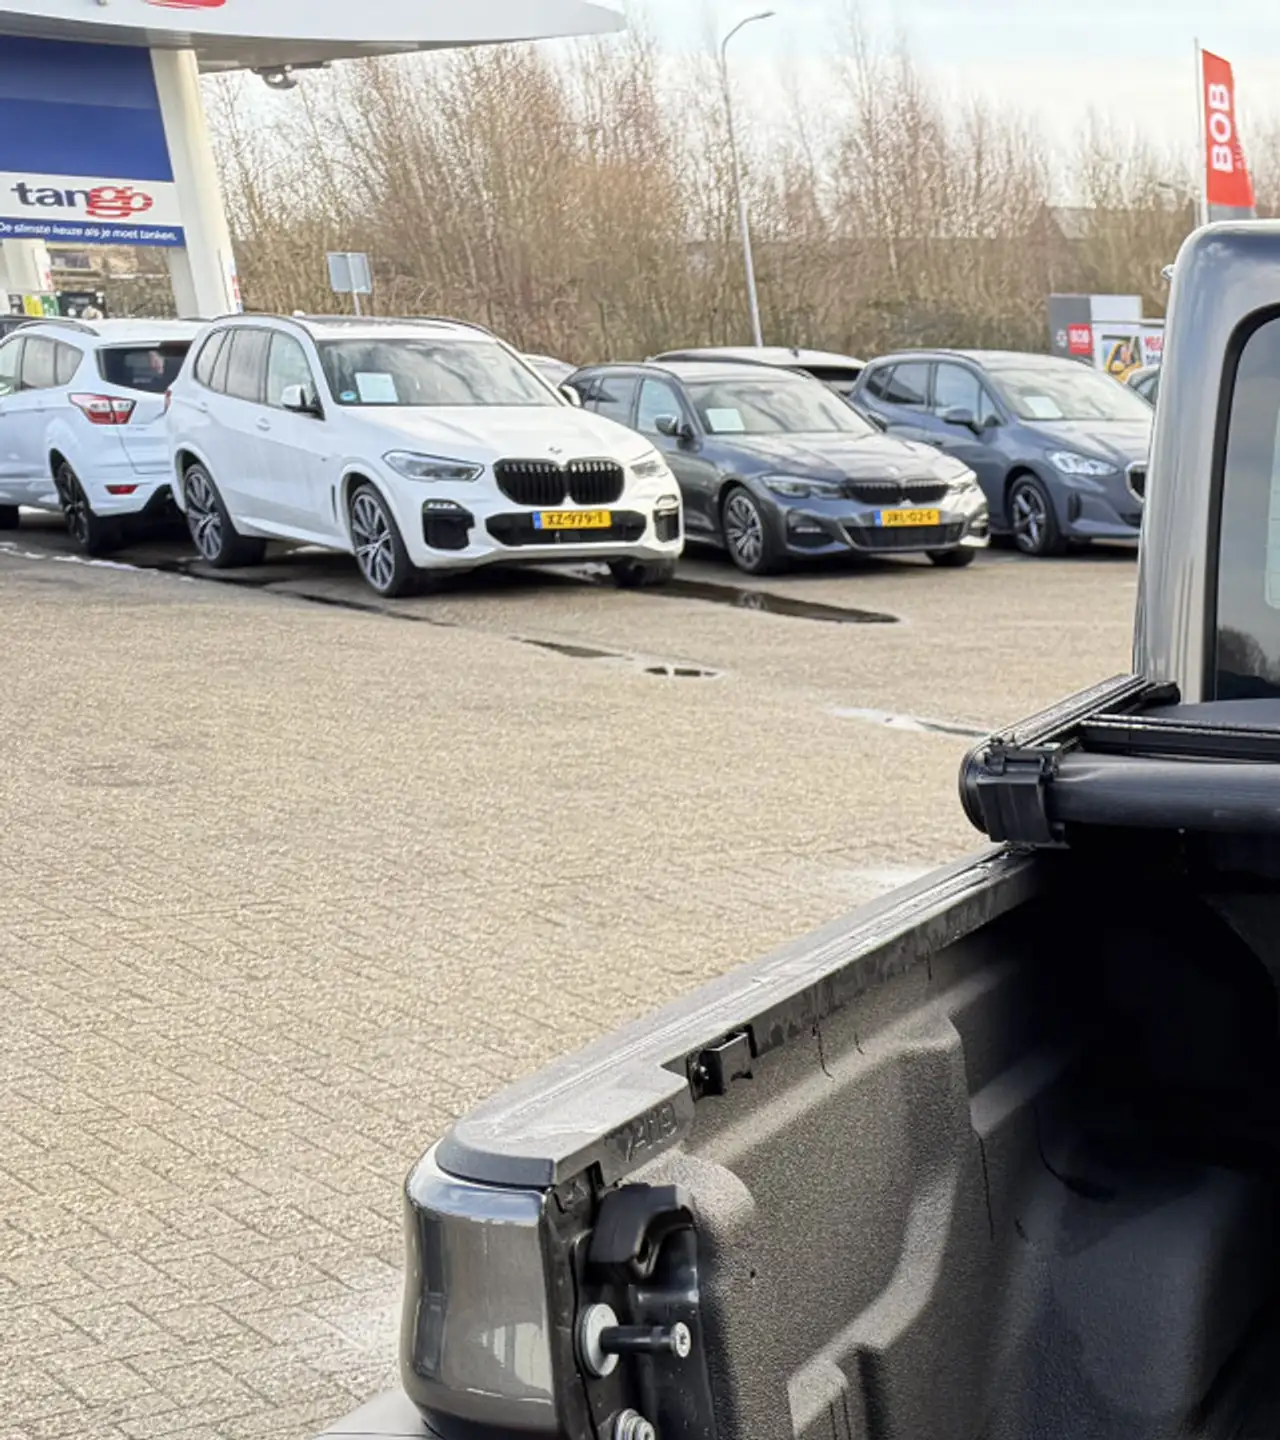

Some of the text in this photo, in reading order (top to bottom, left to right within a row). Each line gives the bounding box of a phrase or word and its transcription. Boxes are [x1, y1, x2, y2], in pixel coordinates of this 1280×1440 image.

[1208, 83, 1234, 173] BOB
[10, 182, 153, 219] tango
[101, 227, 111, 239] je
[112, 229, 138, 239] moet
